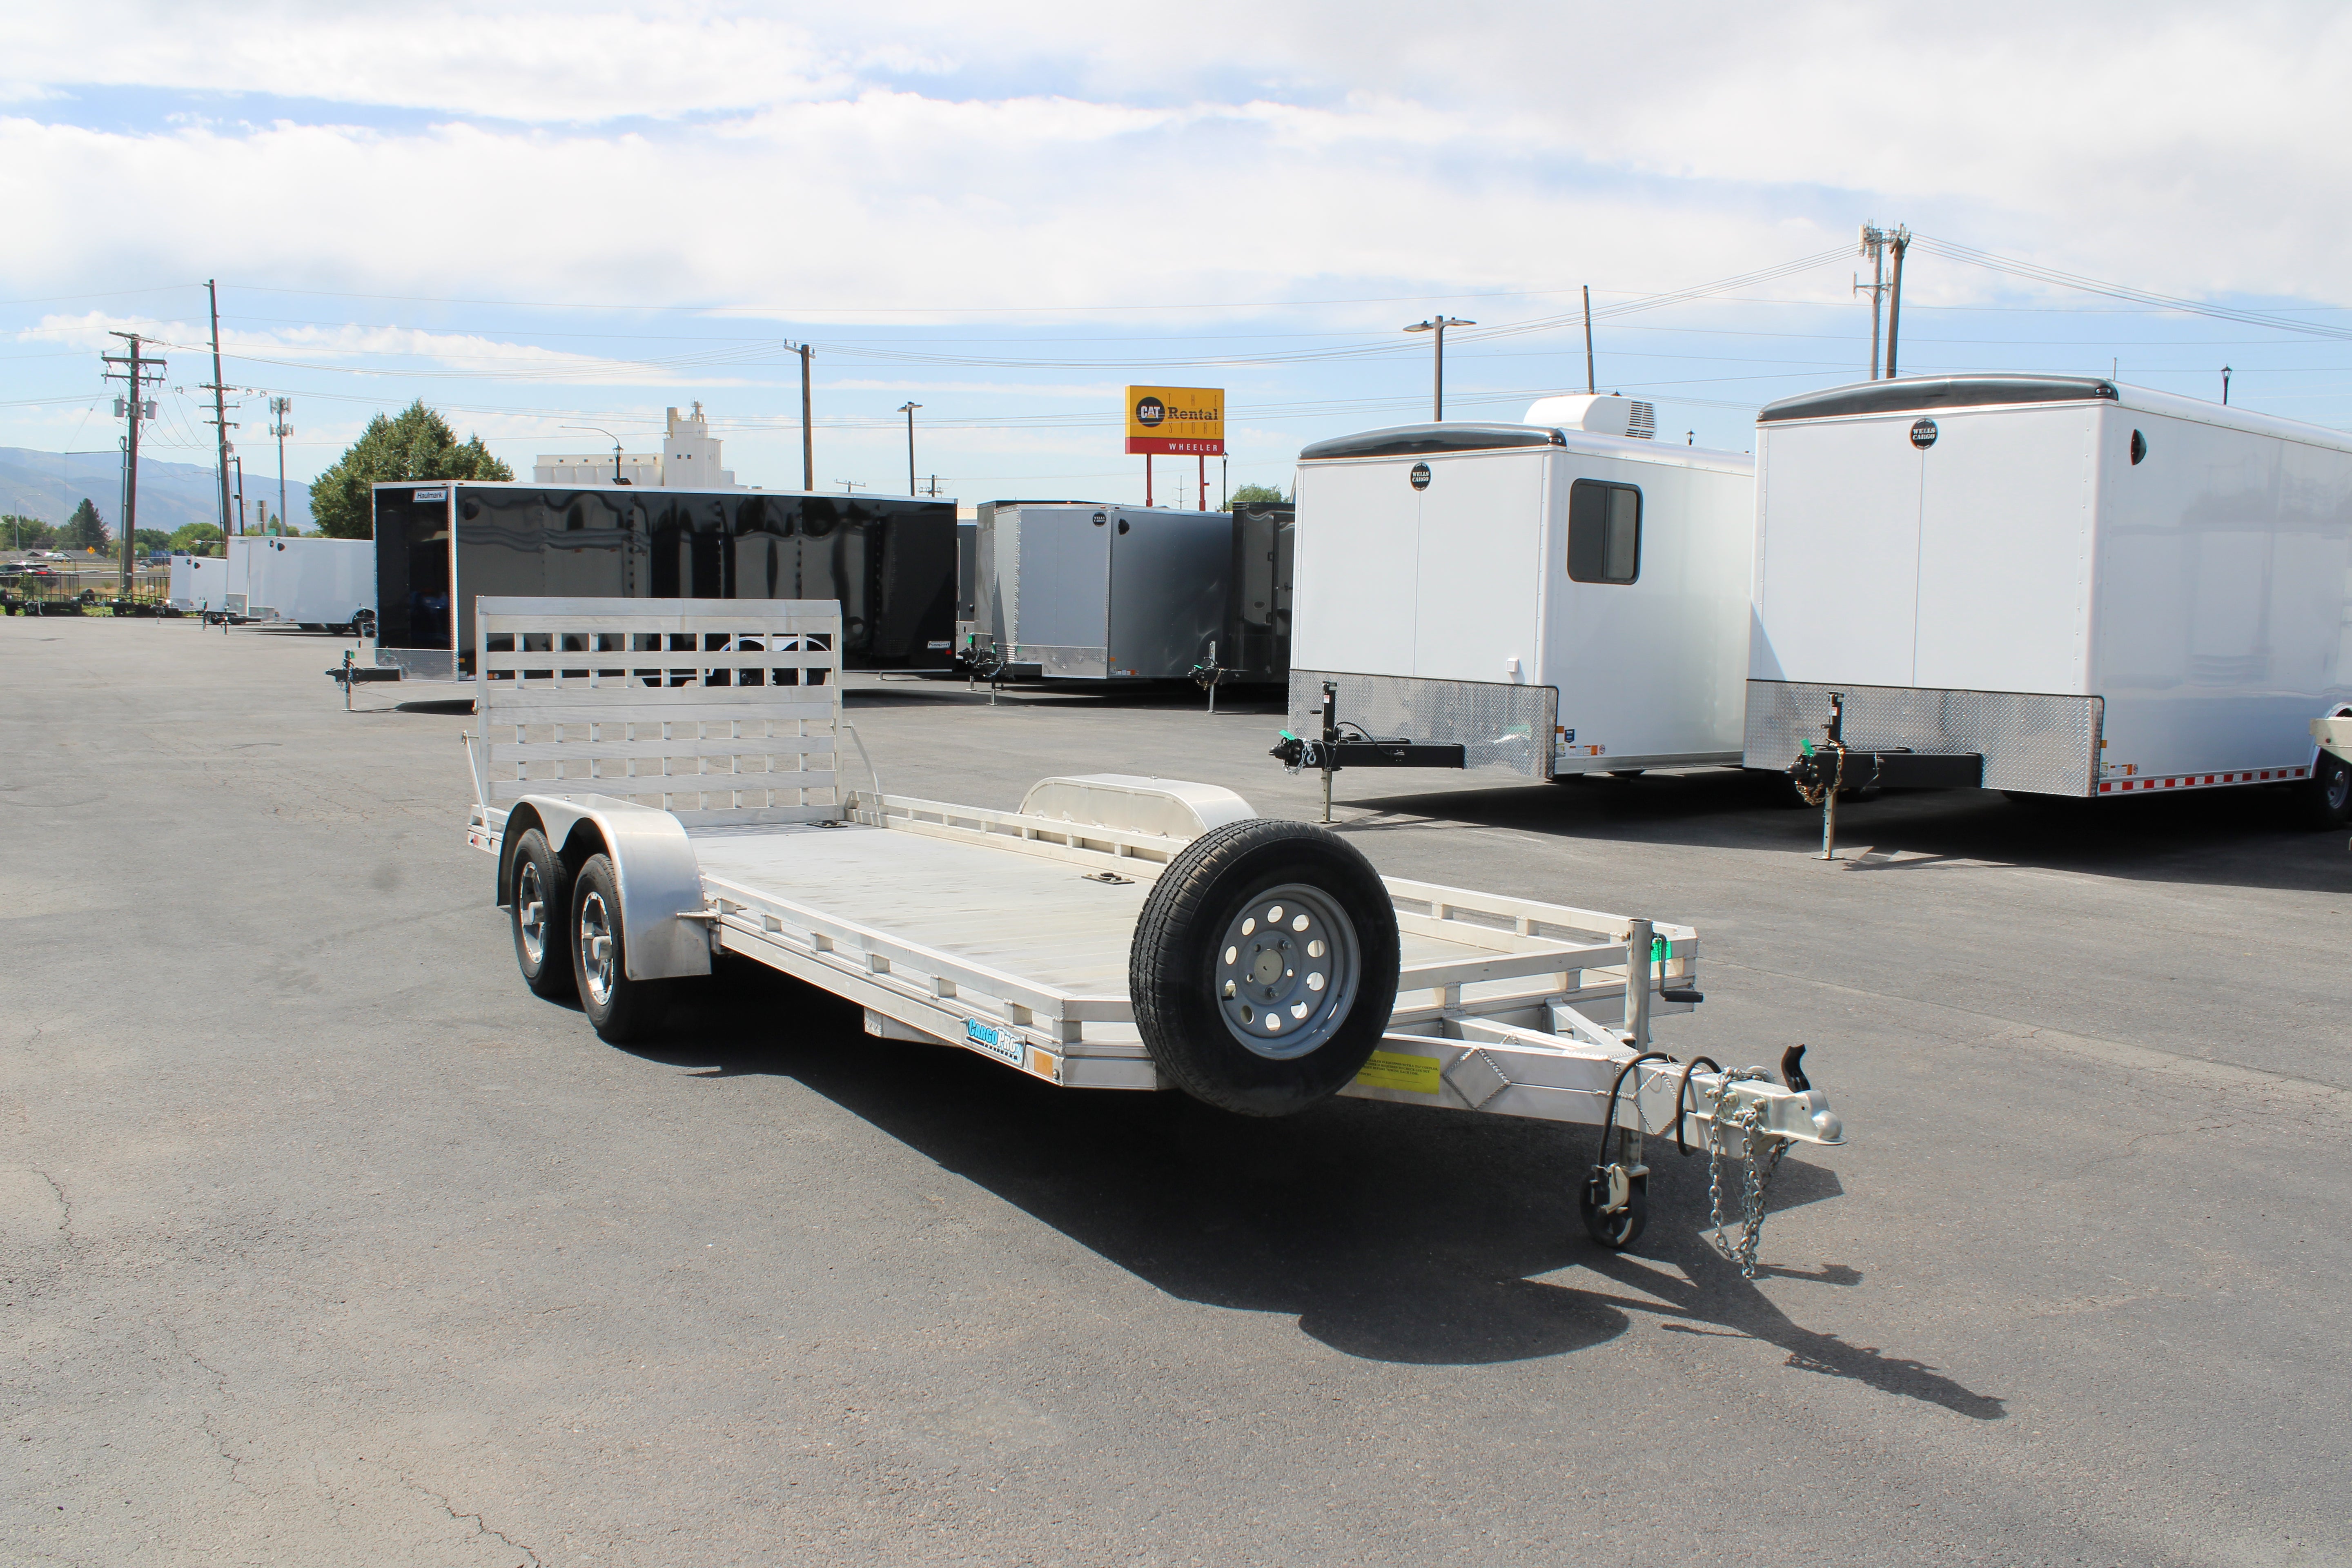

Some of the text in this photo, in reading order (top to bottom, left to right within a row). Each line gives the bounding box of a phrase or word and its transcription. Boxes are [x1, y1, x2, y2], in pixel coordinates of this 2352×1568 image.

[1168, 393, 1218, 408] THE
[1140, 405, 1160, 419] CAT
[1167, 406, 1218, 421] Rental
[1169, 421, 1218, 435] STORE
[1169, 443, 1218, 452] WHEELER
